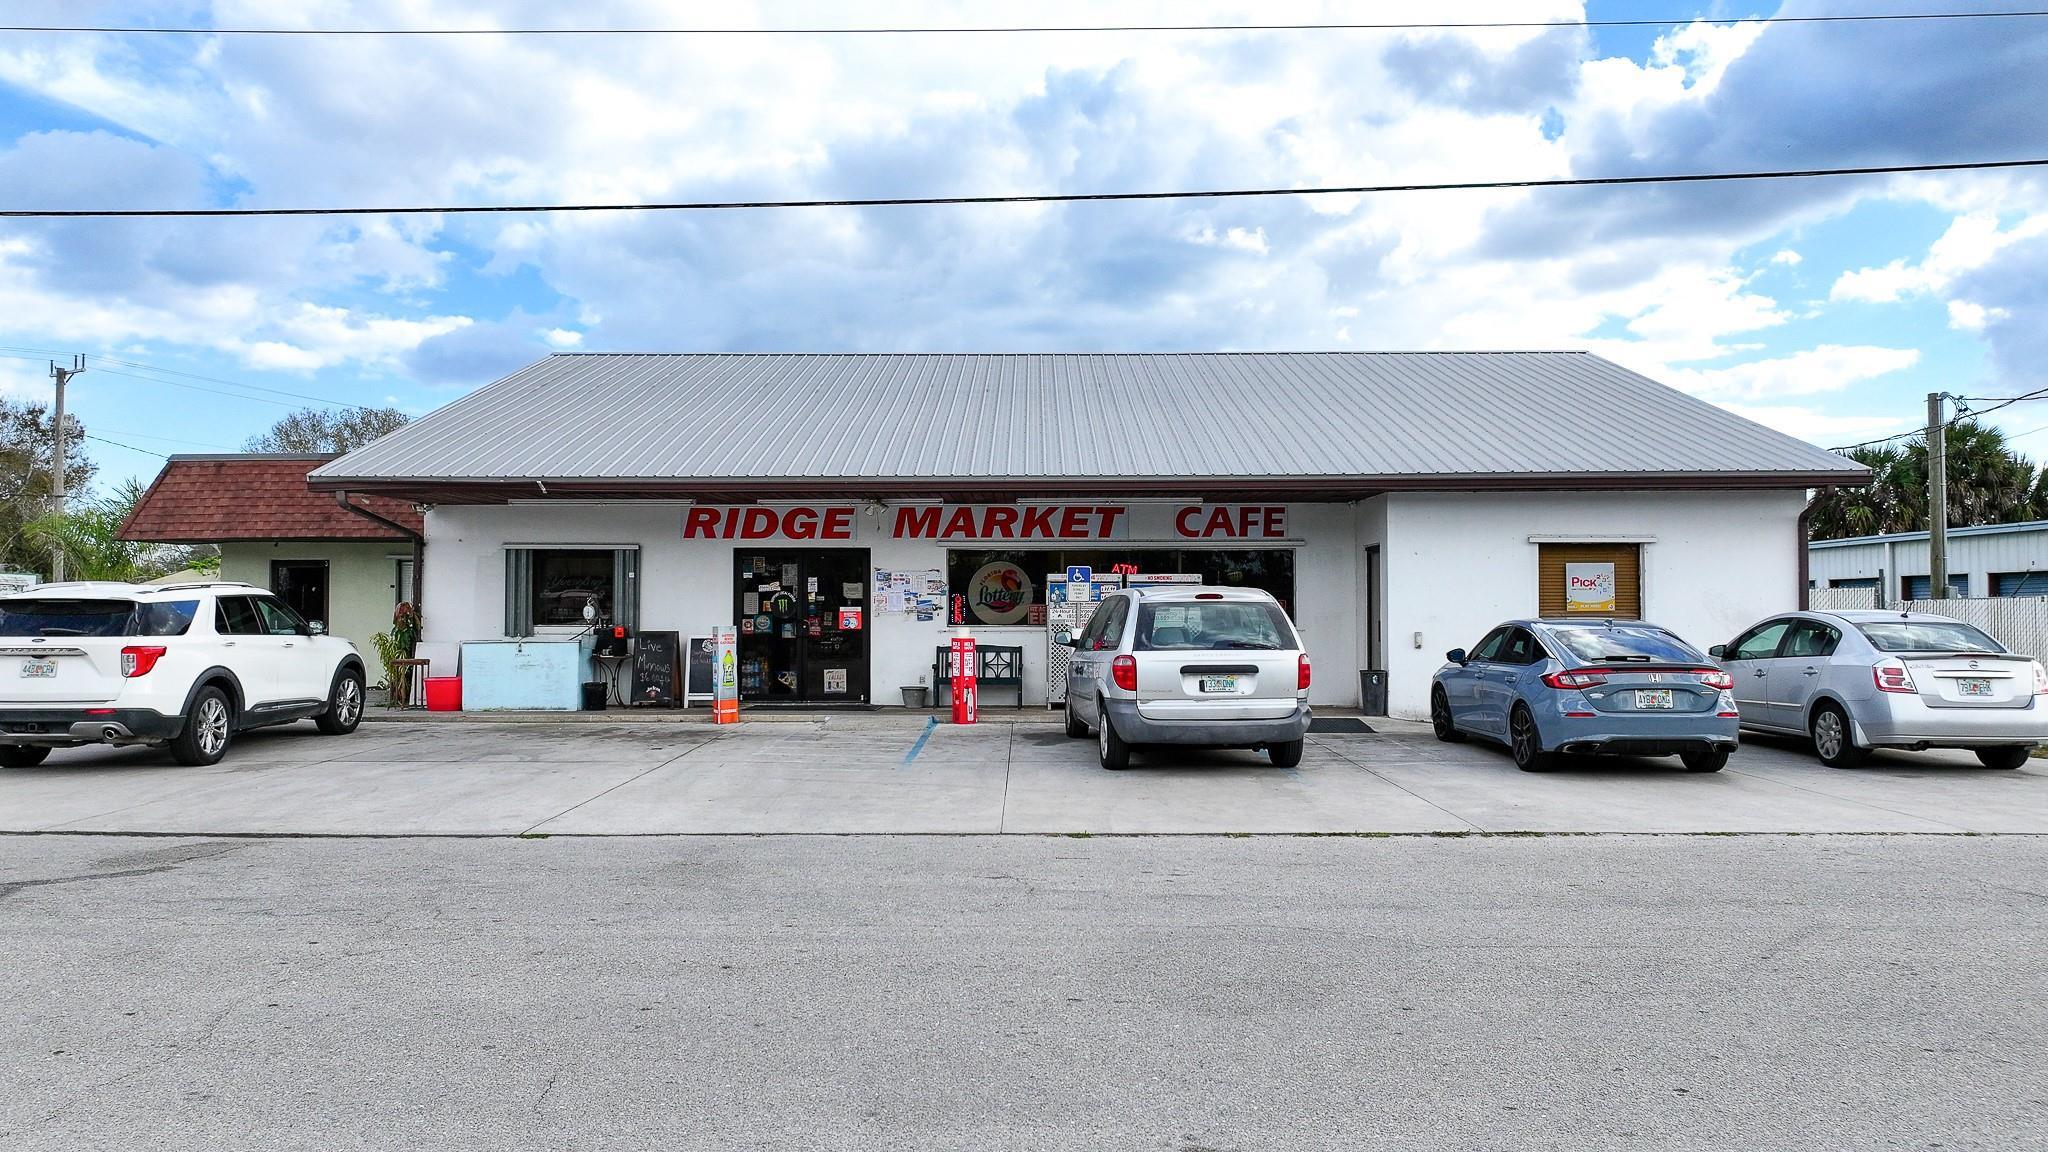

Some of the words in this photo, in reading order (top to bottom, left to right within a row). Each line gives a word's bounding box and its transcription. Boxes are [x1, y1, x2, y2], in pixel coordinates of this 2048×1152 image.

[683, 507, 855, 539] RIDGE
[892, 506, 1125, 539] MARKET
[1174, 506, 1286, 538] CAFE
[1112, 563, 1138, 575] ATM
[980, 569, 1002, 586] FLORIDA
[1571, 576, 1597, 587] PICK
[976, 585, 1025, 608] Lottery
[639, 637, 663, 652] Live
